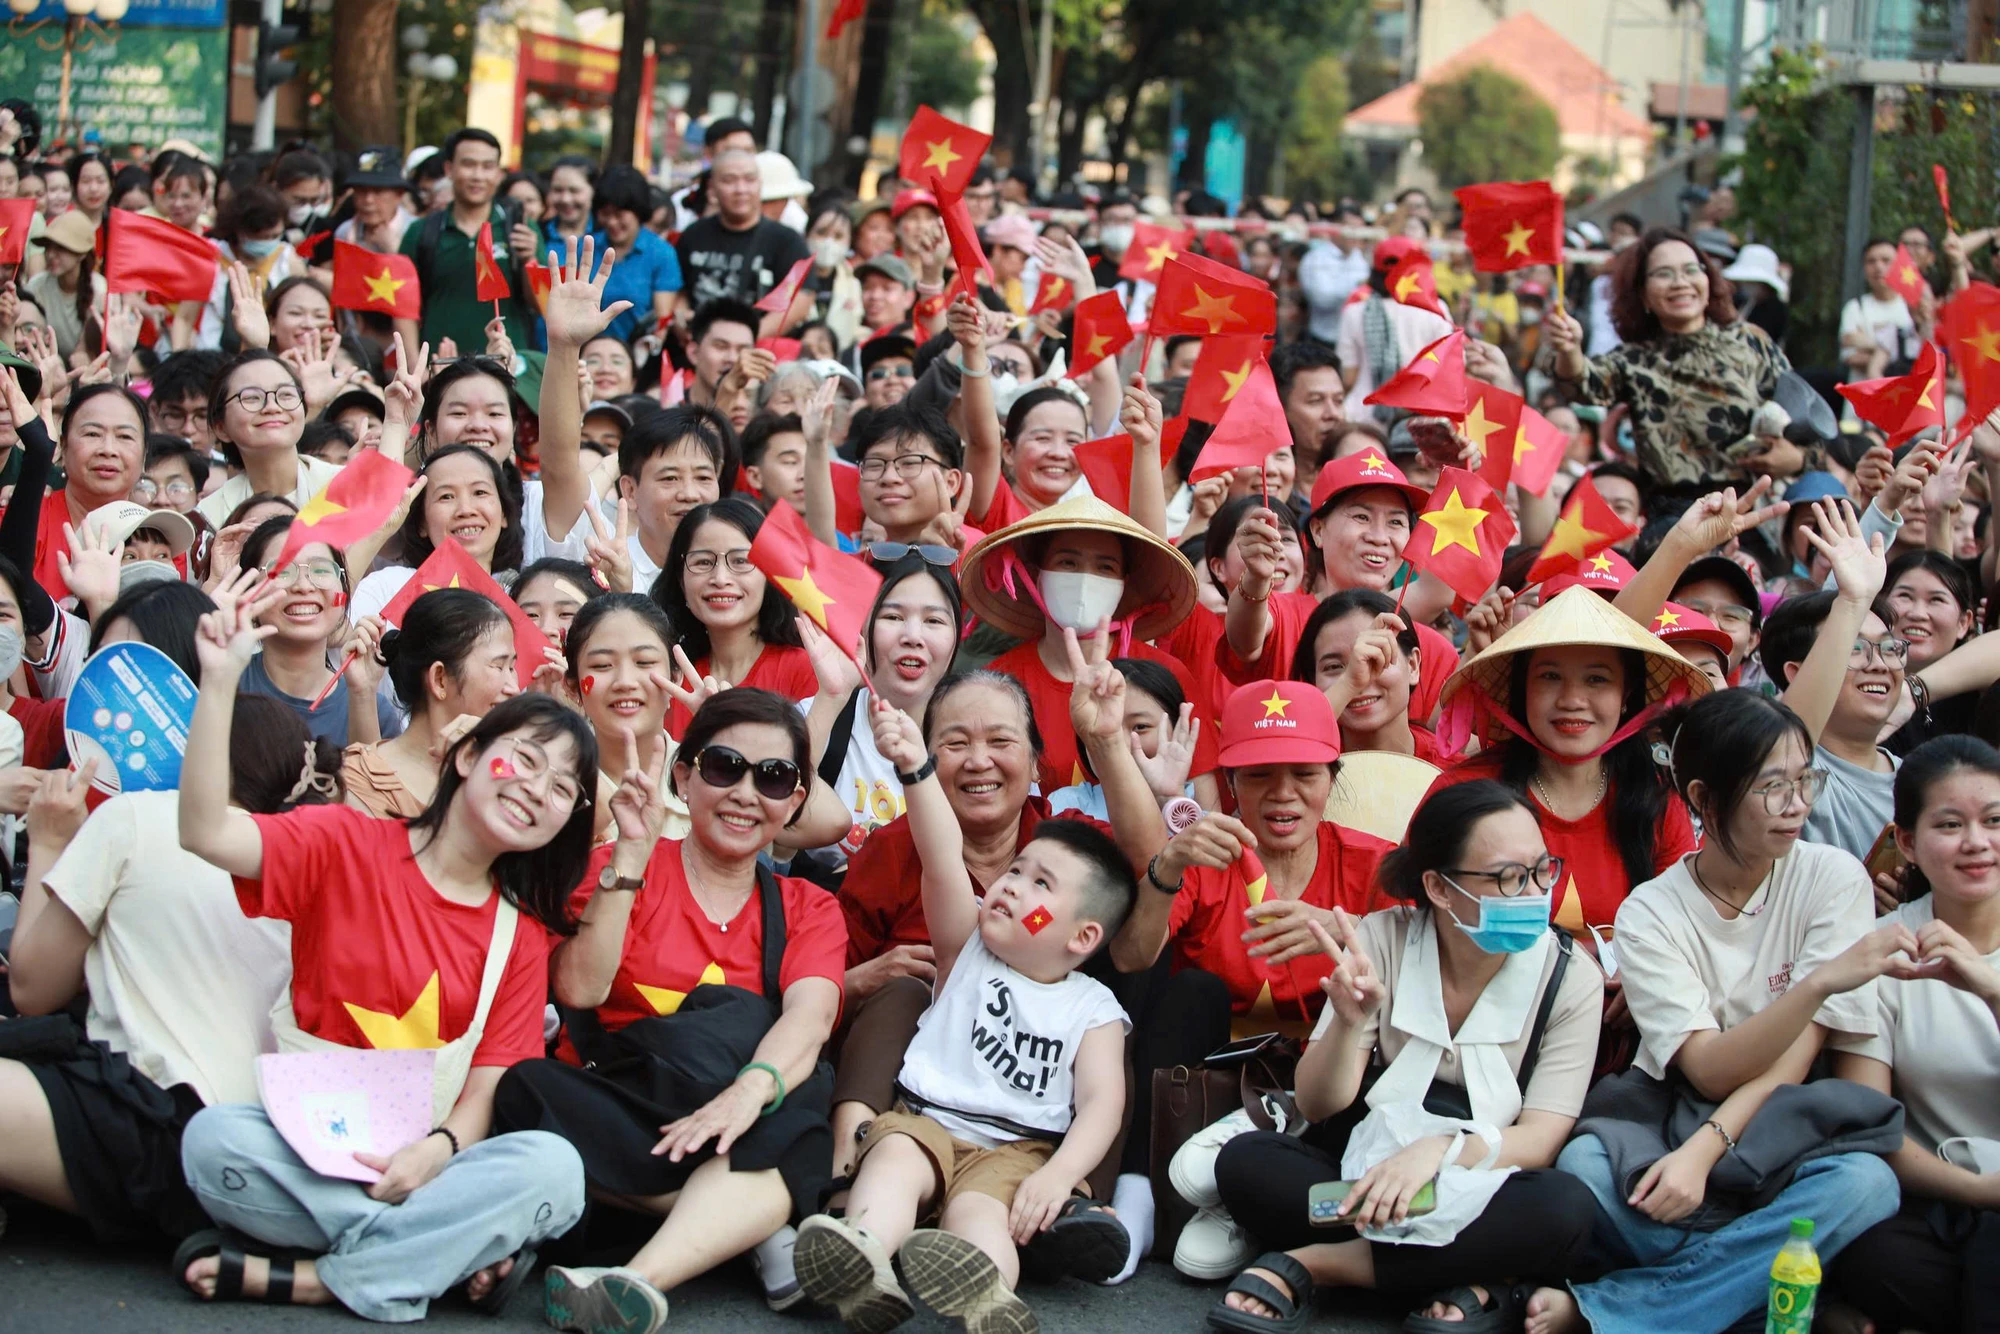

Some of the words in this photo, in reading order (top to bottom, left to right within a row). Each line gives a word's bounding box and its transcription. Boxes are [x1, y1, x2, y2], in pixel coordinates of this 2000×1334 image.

[1378, 471, 1394, 480] NAM
[1583, 571, 1601, 579] VIỆT
[1603, 573, 1619, 583] NAM
[1254, 718, 1274, 729] VIỆT
[1276, 719, 1297, 728] NAM
